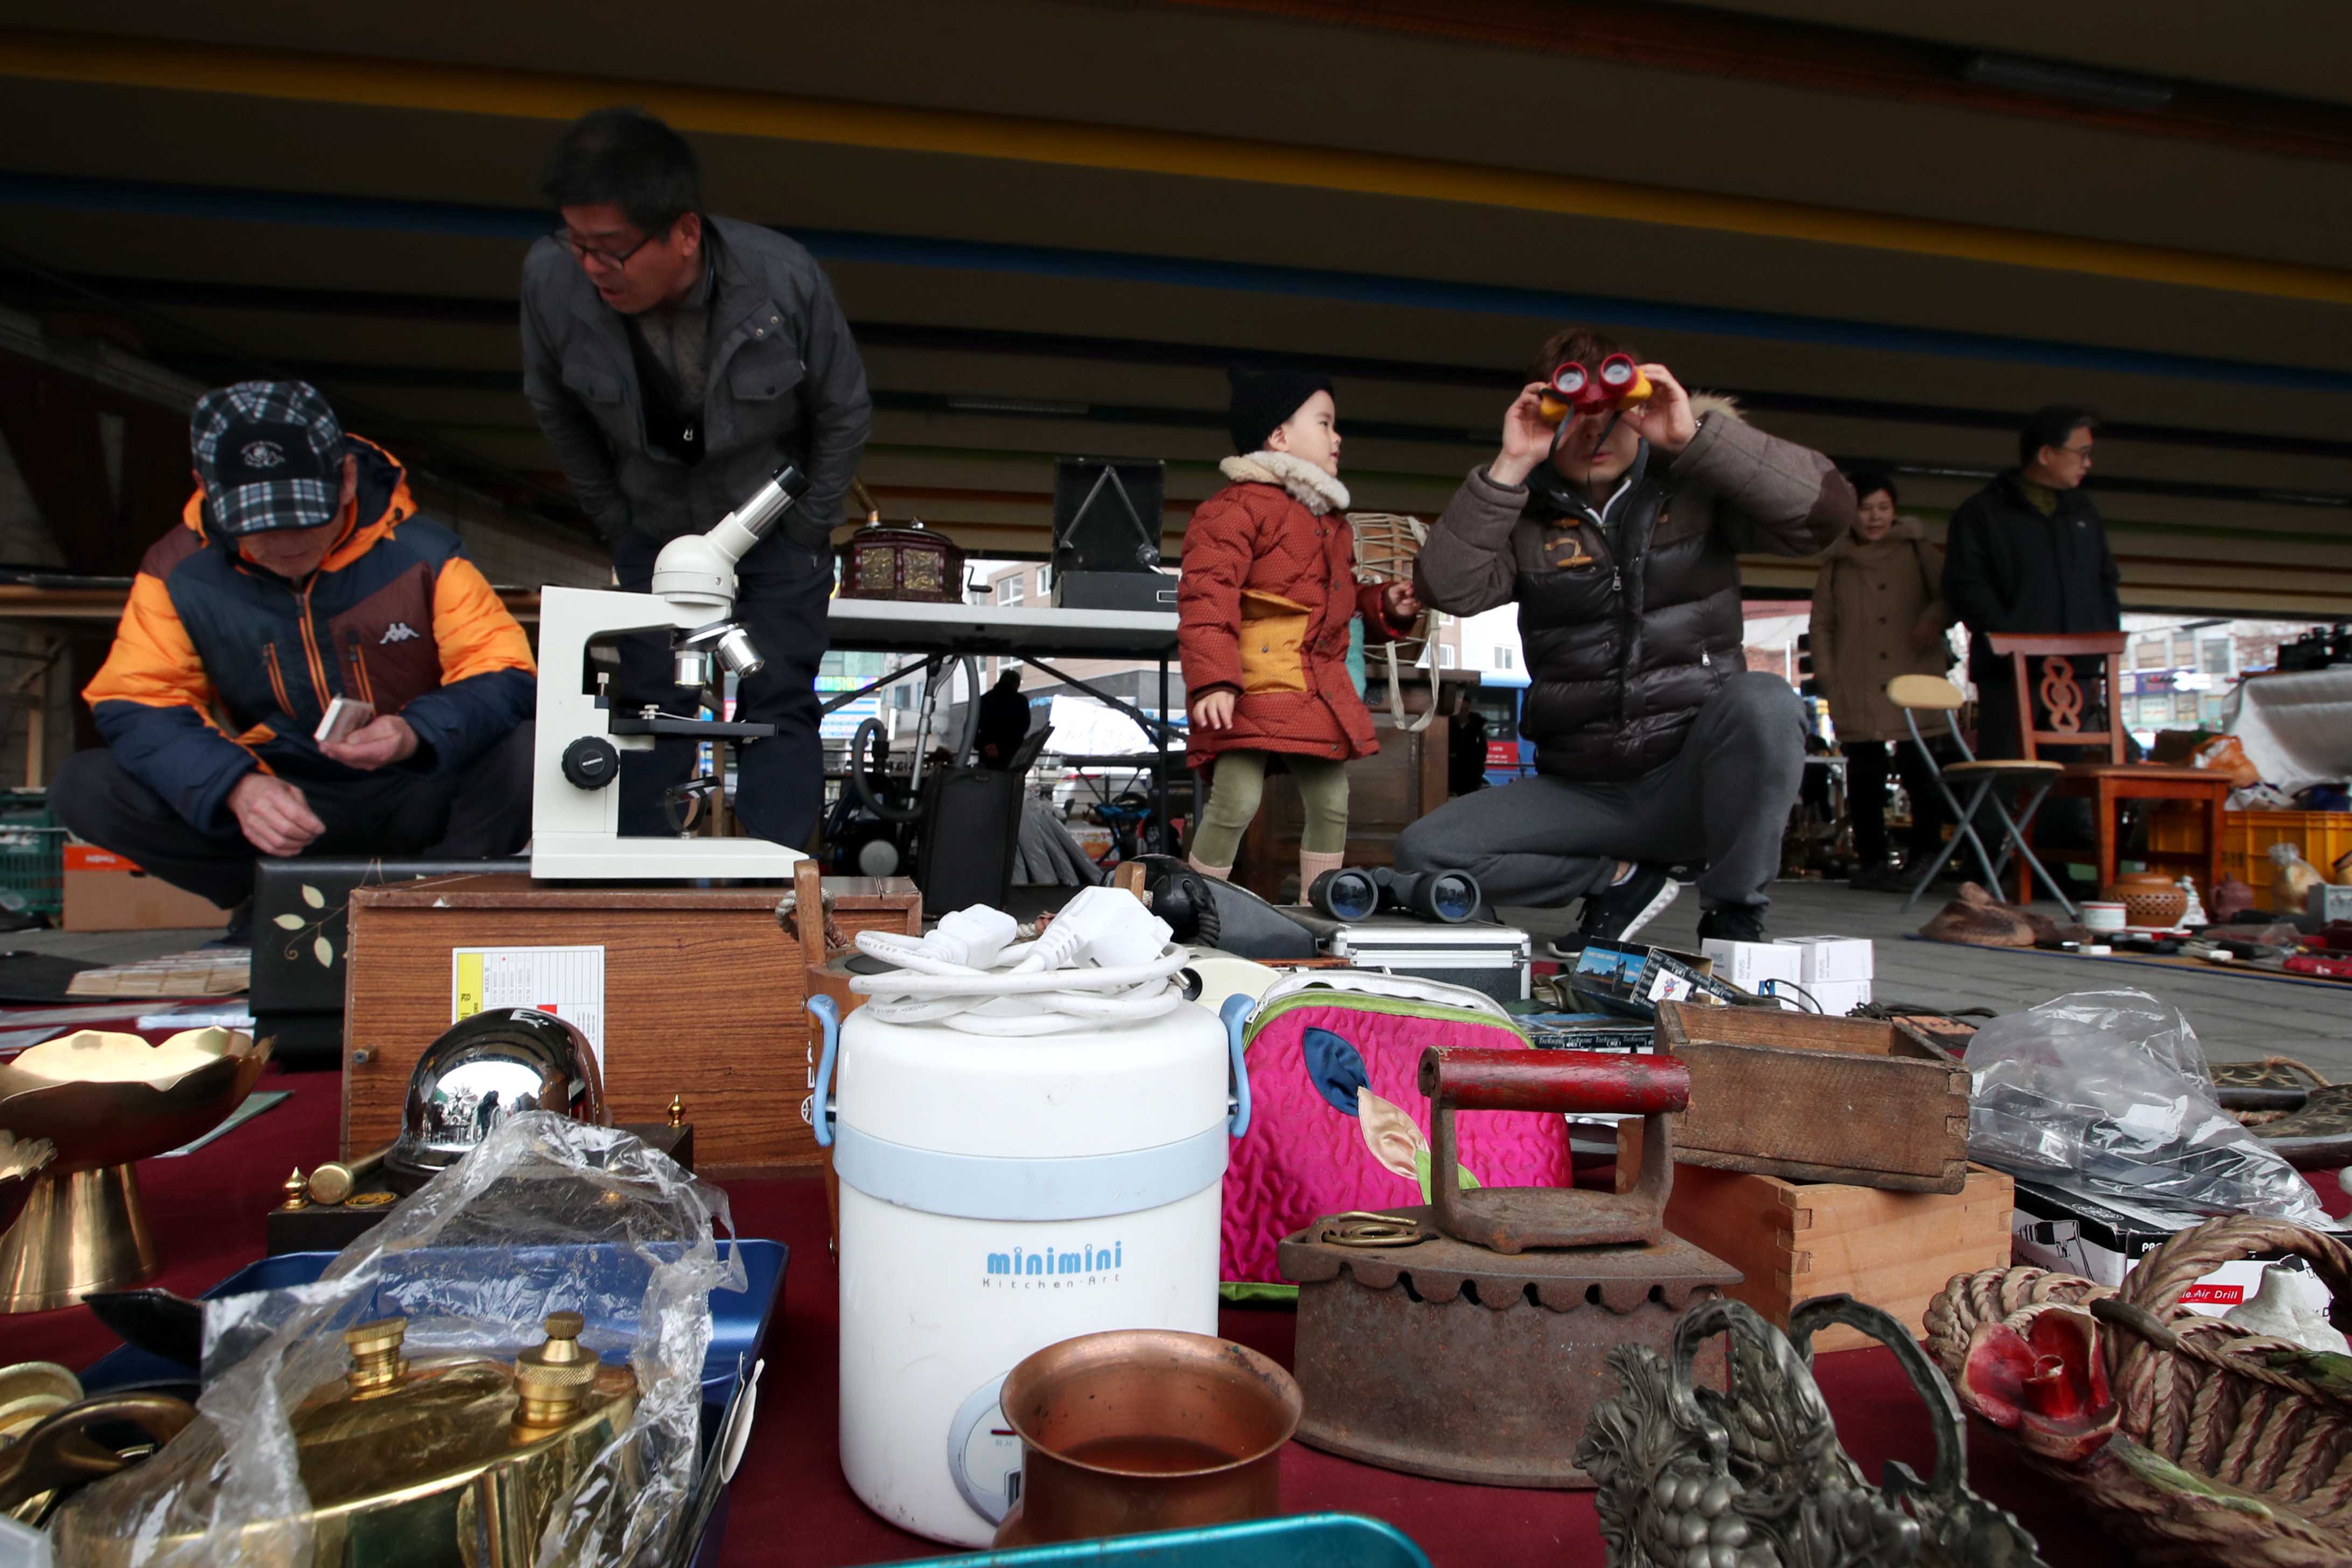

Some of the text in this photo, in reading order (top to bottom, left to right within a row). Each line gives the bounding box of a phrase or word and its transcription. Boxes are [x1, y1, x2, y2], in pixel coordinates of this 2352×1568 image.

[987, 1241, 1122, 1275] minimini
[2195, 1289, 2210, 1299] Air
[2214, 1290, 2238, 1299] Drill
